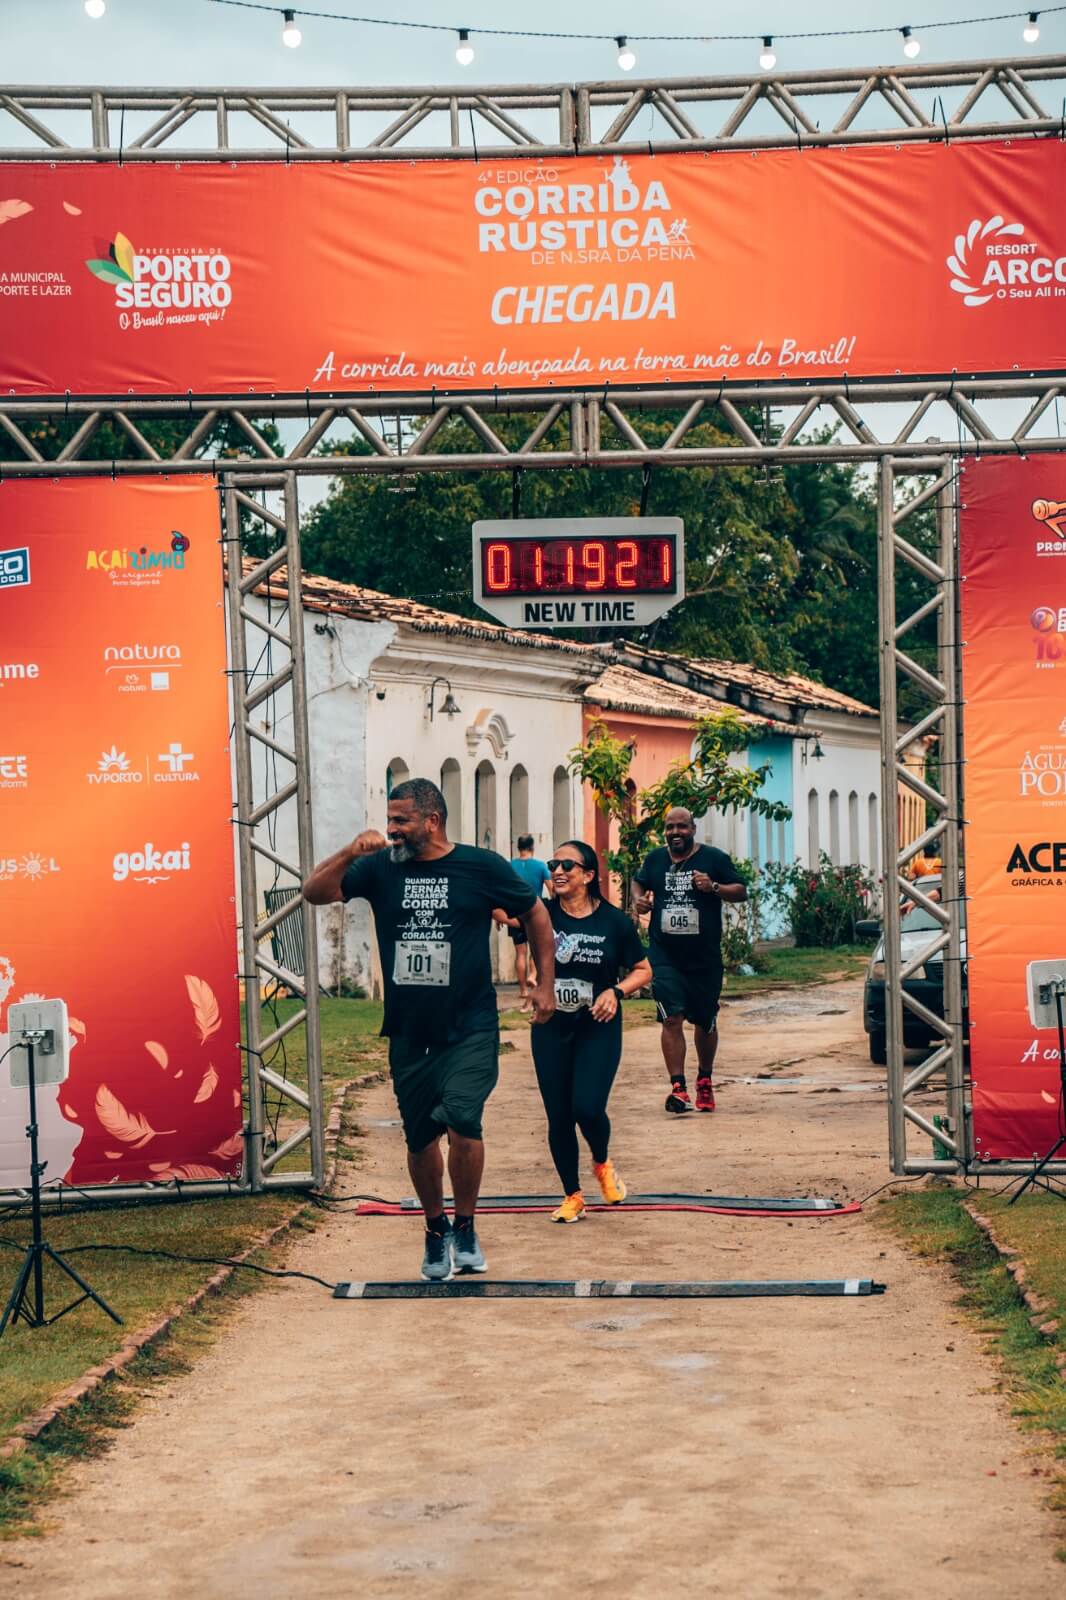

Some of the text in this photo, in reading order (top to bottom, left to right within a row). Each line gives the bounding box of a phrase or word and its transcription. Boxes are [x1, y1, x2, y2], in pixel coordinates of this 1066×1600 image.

[496, 167, 559, 185] EDIÇÃO
[474, 180, 671, 216] CORRIDA
[478, 214, 670, 252] RÚSTICA
[531, 246, 695, 265] DE N.SRA DA PENA
[986, 243, 1038, 256] RESORT
[132, 255, 231, 281] PORTO
[10, 272, 66, 283] MUNICIPAL
[32, 285, 38, 296] E
[40, 285, 72, 296] LAZER
[115, 281, 232, 308] SEGURO
[996, 289, 1007, 299] O
[1009, 288, 1033, 298] Seu
[1035, 287, 1052, 297] All
[490, 281, 677, 325] CHEGADA
[119, 312, 130, 330] O
[132, 310, 164, 329] Brasil
[165, 314, 198, 324] nasceu
[313, 336, 857, 382] A corrida mais abençoada na terra mãe do Brasil!
[524, 601, 635, 622] NEW TIME
[104, 644, 181, 660] natura
[1020, 751, 1066, 770] ÁGU
[154, 772, 200, 782] CULTURA
[1020, 770, 1066, 796] PO
[113, 842, 190, 881] gokai
[404, 885, 448, 893] PERNAS
[1011, 878, 1053, 887] GRÁFICA
[402, 900, 448, 909] CORRA
[670, 916, 688, 927] 045
[402, 931, 444, 941] CORAÇÃO
[406, 954, 432, 973] 101
[557, 989, 579, 1004] 108
